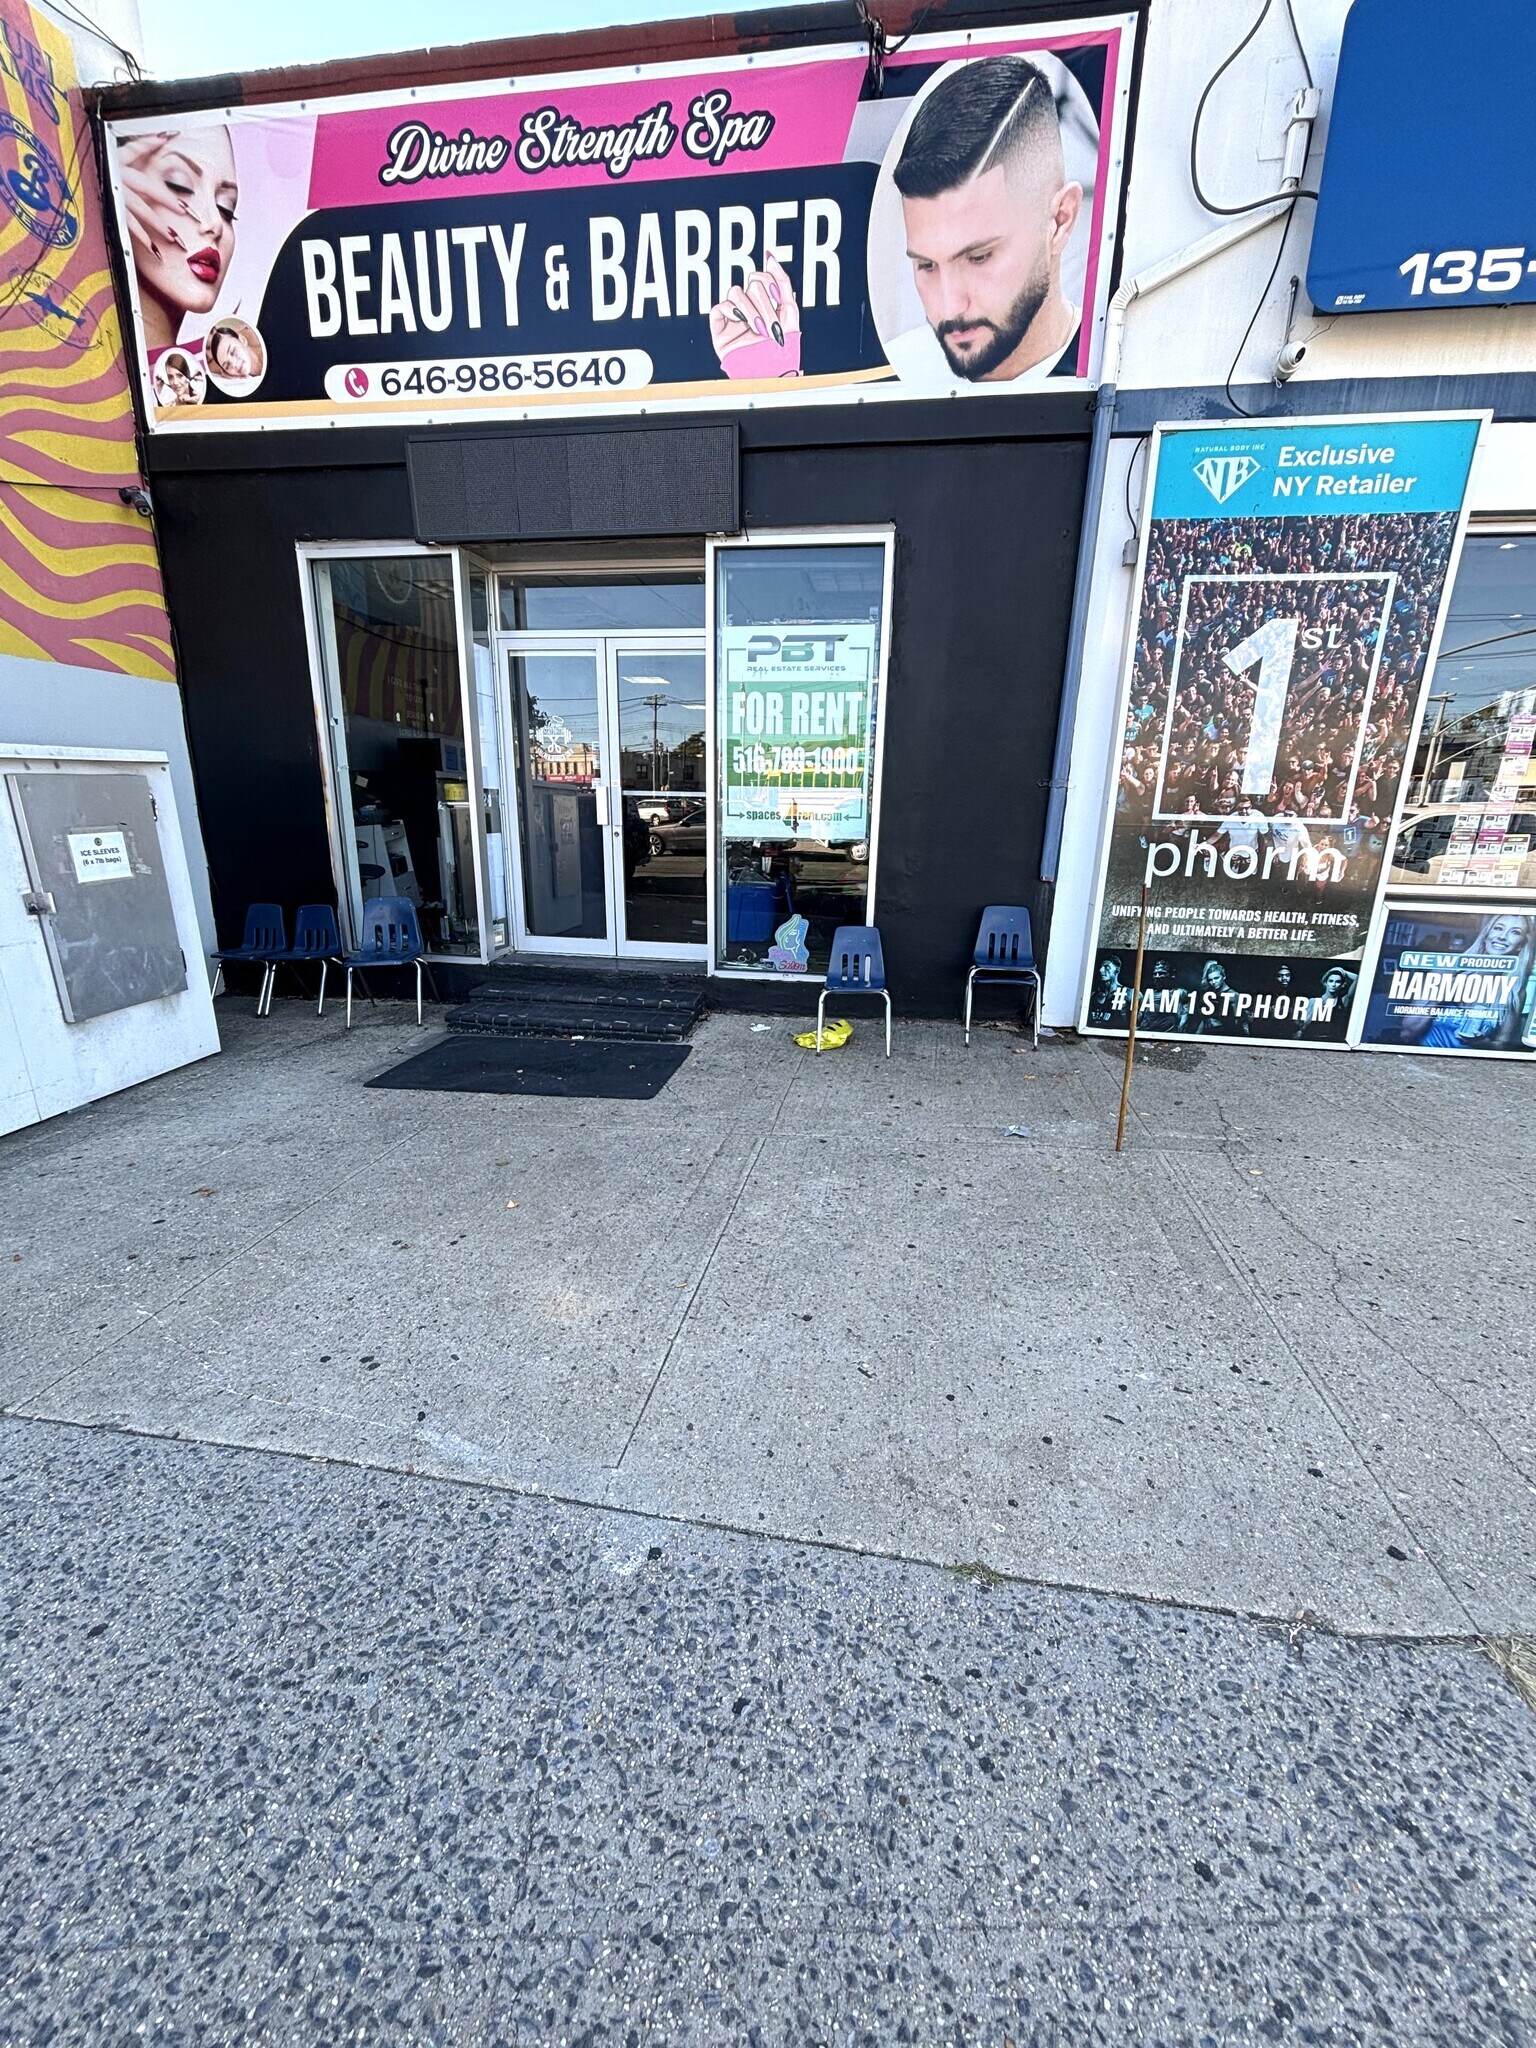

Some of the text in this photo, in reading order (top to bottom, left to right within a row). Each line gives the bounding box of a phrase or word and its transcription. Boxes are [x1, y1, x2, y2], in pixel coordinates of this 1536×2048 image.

[382, 92, 771, 181] Divine Strength Spa
[301, 198, 842, 338] BEAUTY & BARBER
[381, 356, 626, 396] 646-986-5640
[1229, 444, 1250, 452] BODY
[1278, 444, 1395, 467] Exclusive
[1272, 473, 1418, 497] NY Retailer
[747, 634, 848, 662] PBT
[732, 691, 863, 735] FOR RENT
[93, 847, 120, 856] SLEEVES
[106, 856, 122, 865] bags)
[1144, 829, 1344, 888] phorm
[1165, 907, 1207, 921] PEOPLE
[1208, 908, 1261, 922] TOWARDS
[1264, 910, 1308, 925] HEALTH,
[1311, 912, 1360, 928] FITNESS,
[1147, 923, 1317, 942] AND ULTIMATELY A BETTER LIFE.
[1403, 953, 1515, 969] NEW PRODUCT
[1388, 970, 1518, 1005] HARMONY
[1394, 1005, 1499, 1019] HORMONE BALANCE FORMULA
